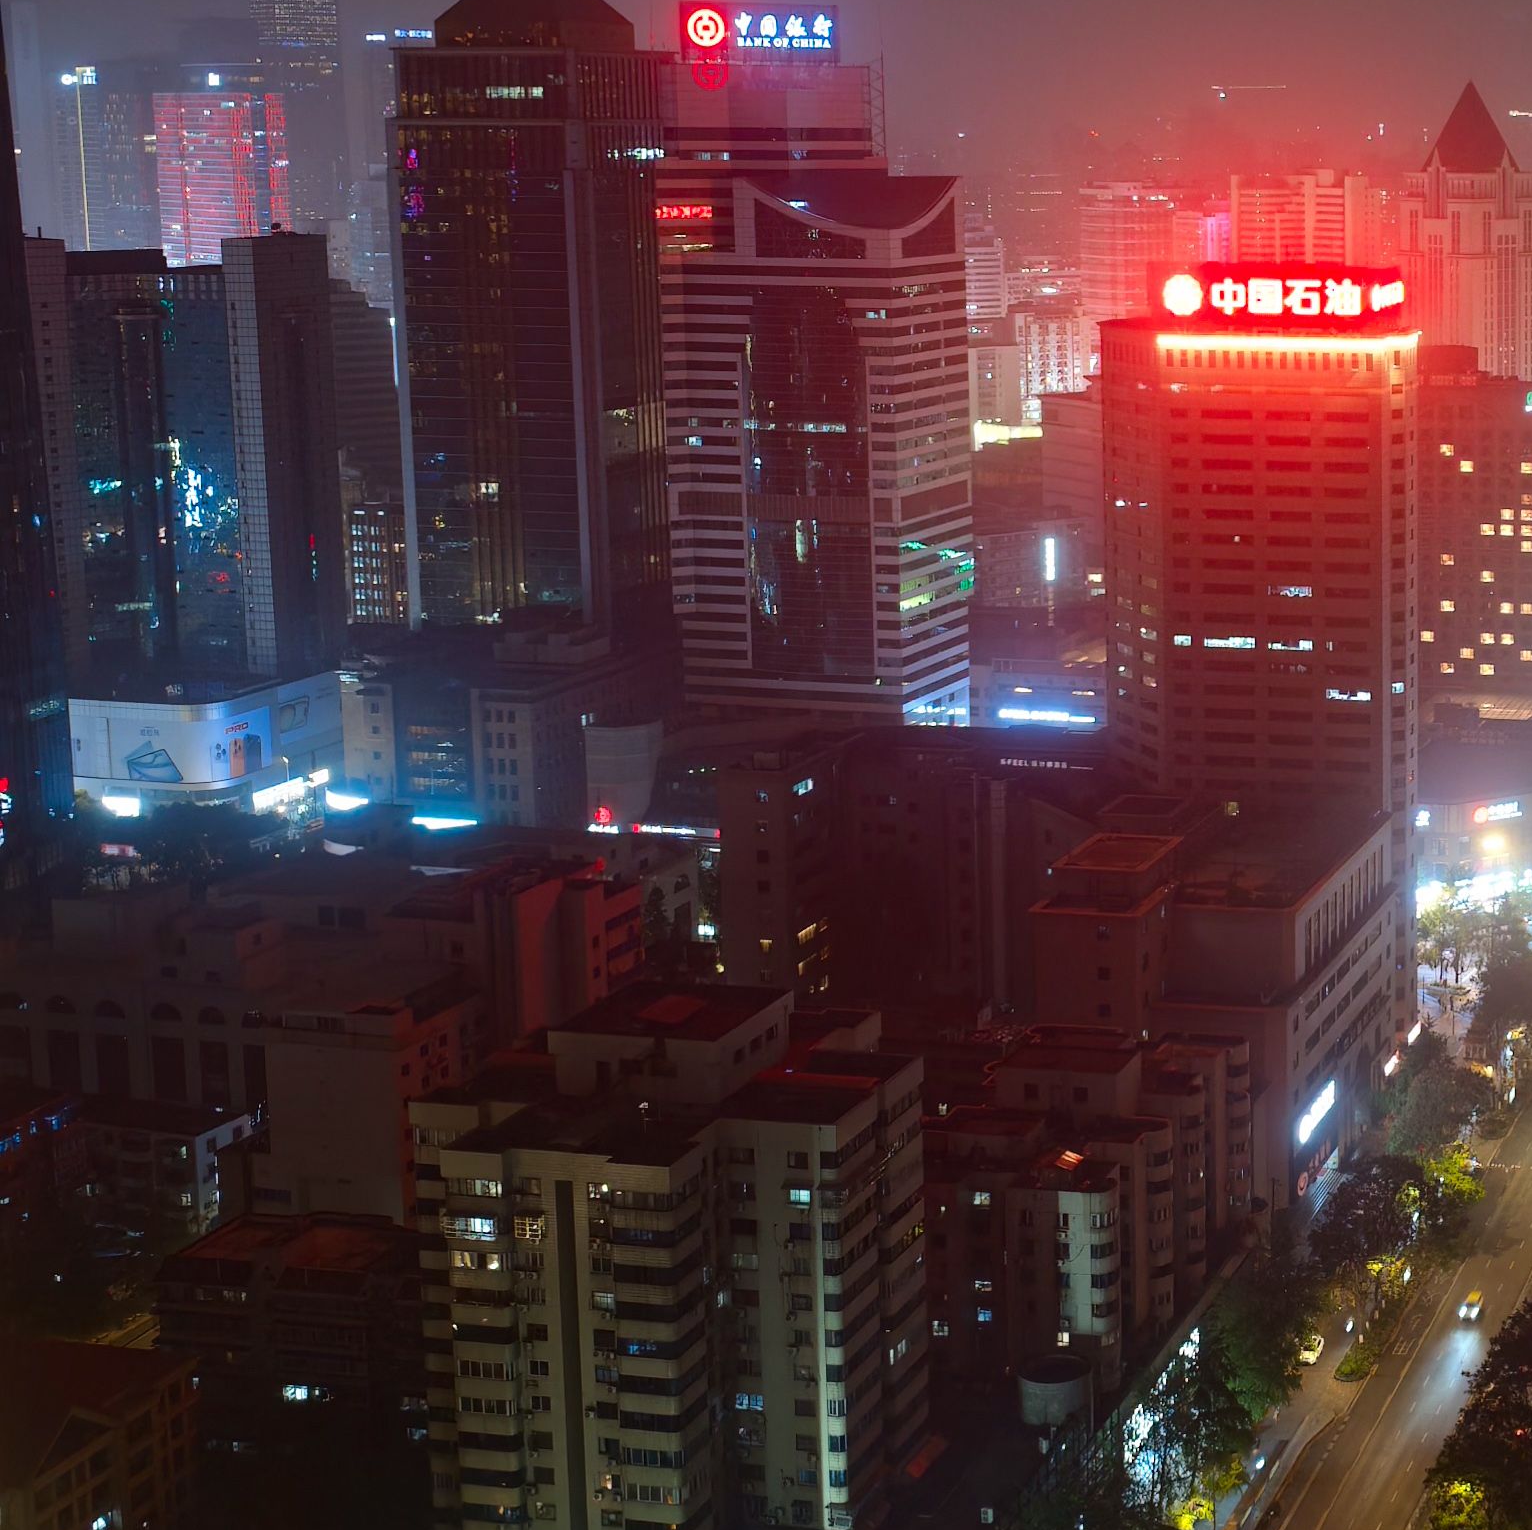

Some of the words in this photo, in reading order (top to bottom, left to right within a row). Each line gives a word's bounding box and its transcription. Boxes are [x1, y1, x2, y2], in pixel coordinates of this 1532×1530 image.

[734, 11, 833, 38] 中国银行
[737, 37, 770, 48] BANK
[773, 37, 790, 48] OF
[792, 37, 832, 49] CHINA
[1212, 278, 1361, 316] 中国石油
